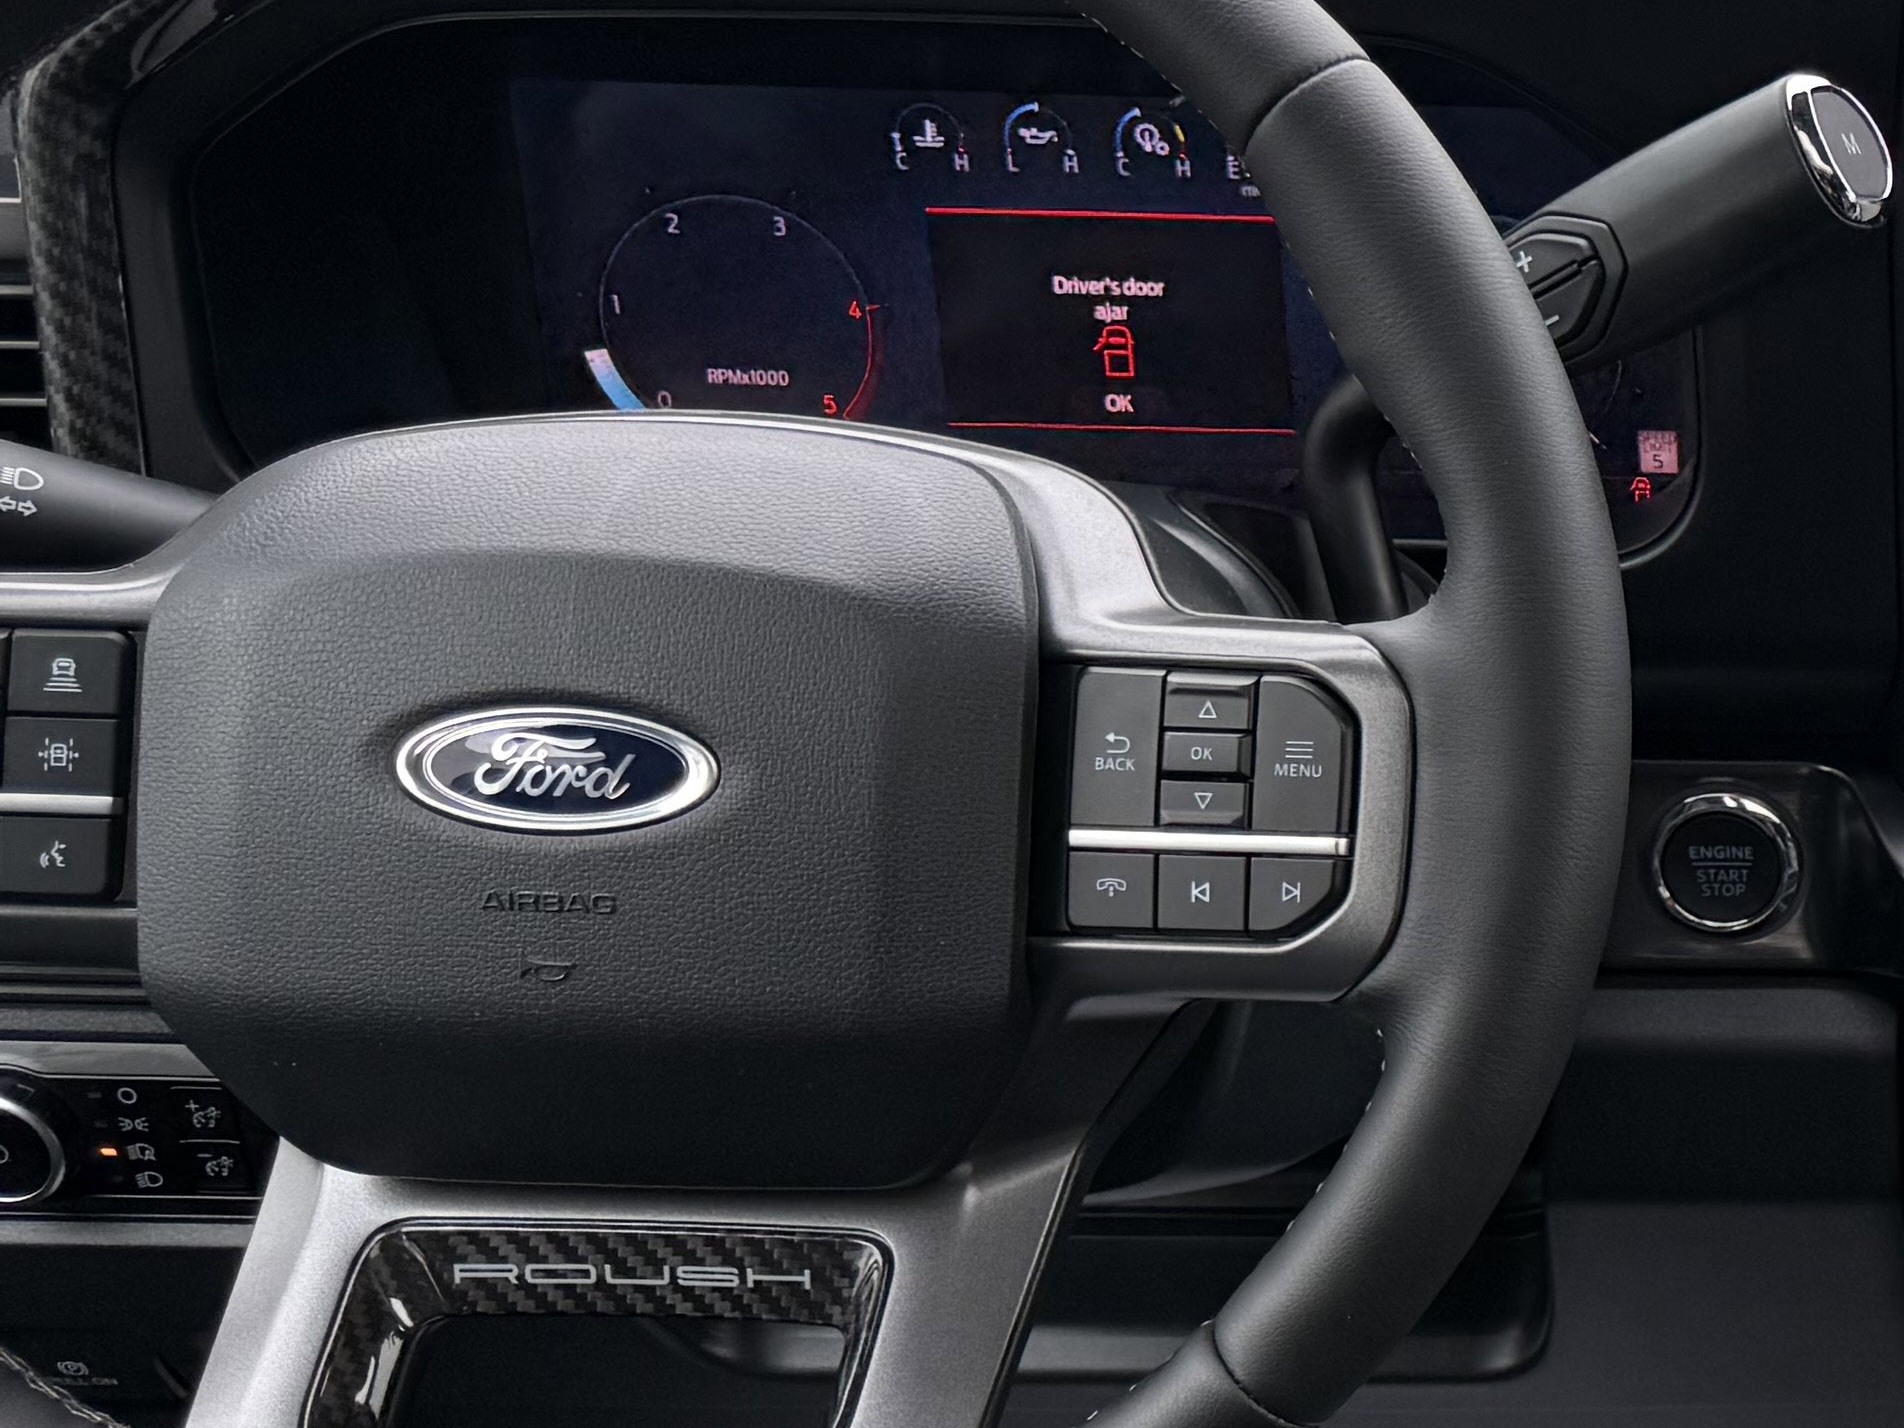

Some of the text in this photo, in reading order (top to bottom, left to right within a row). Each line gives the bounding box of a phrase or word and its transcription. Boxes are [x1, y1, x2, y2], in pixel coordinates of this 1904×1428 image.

[1842, 133, 1861, 156] M
[667, 214, 680, 236] 2
[773, 217, 787, 237] 3
[1052, 275, 1165, 298] Driver's door
[611, 295, 621, 314] 1
[847, 301, 861, 319] 4
[1094, 304, 1129, 323] ajar
[658, 391, 672, 409] 0
[823, 396, 837, 415] 5
[1104, 395, 1133, 414] OK
[1191, 746, 1213, 761] OK
[474, 732, 636, 800] Ford
[1095, 757, 1135, 772] BACK
[1273, 763, 1322, 778] MENU
[1688, 845, 1754, 861] ENGINE
[1696, 869, 1749, 884] START
[1701, 882, 1747, 898] STOP
[480, 889, 619, 915] AIRBAG
[453, 1261, 812, 1292] ROUSH
